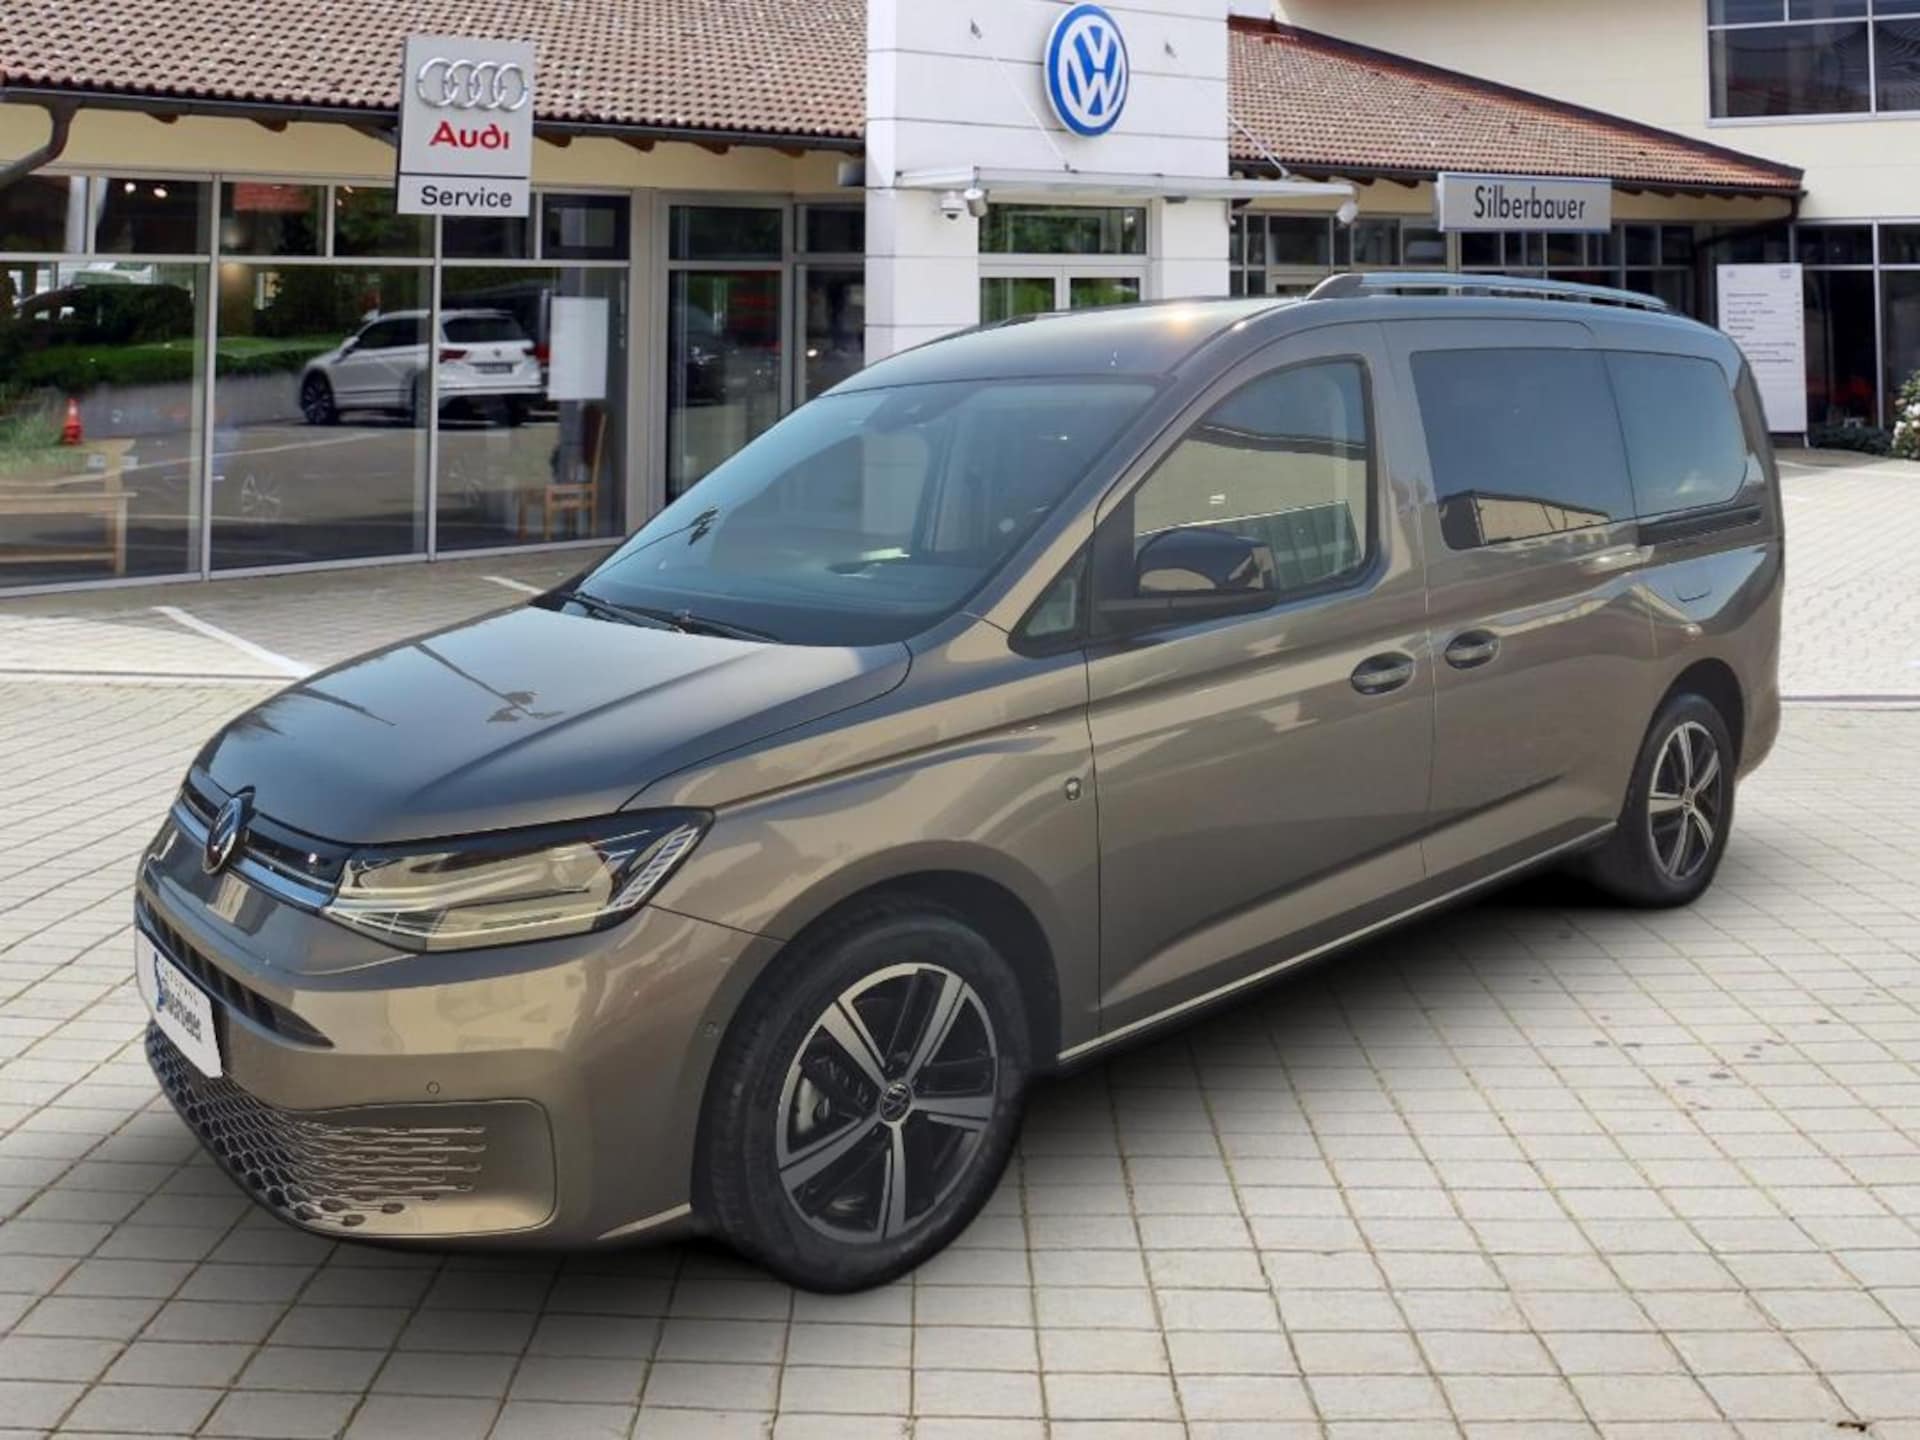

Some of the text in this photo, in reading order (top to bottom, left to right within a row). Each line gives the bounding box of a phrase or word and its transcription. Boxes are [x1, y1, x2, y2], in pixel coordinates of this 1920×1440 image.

[1059, 13, 1123, 128] VW
[429, 120, 510, 150] Audi
[421, 185, 513, 208] Service
[1474, 184, 1586, 219] Silberbauer
